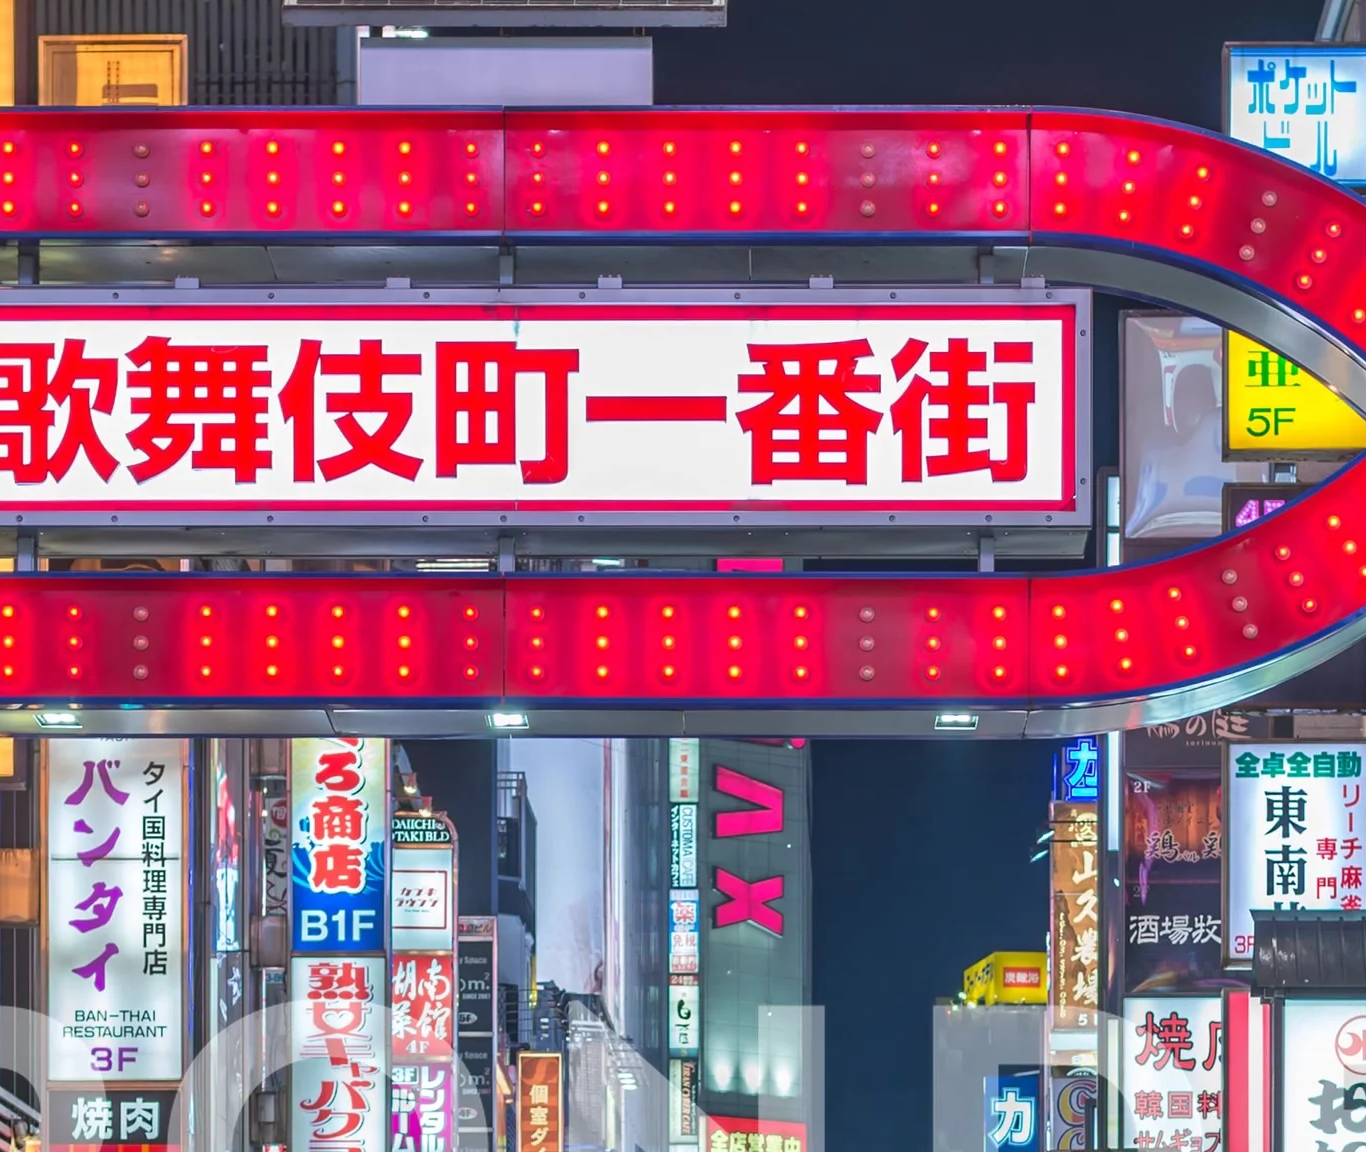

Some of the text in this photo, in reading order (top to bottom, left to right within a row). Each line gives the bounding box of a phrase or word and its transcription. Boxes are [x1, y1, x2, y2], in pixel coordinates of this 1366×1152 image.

[1247, 60, 1357, 115] ポケット
[1263, 121, 1338, 175] ビル
[1247, 407, 1295, 437] 5F
[1235, 752, 1362, 779] 全卓全自動
[1133, 782, 1151, 793] 2F
[313, 738, 367, 892] ろ商店
[392, 819, 435, 831] DAIICHI
[425, 832, 450, 843] BLD
[1264, 786, 1308, 912] 東南
[64, 758, 130, 993] バンタイ
[141, 761, 168, 976] タイ国料理専門店
[1316, 838, 1337, 900] 専門
[302, 910, 376, 942] B1F
[74, 1009, 157, 1024] BAN-THAI
[62, 1026, 167, 1039] RESTAURANT
[405, 1041, 430, 1054] 4F
[90, 1047, 138, 1072] 3F
[72, 1097, 160, 1141] 焼肉
